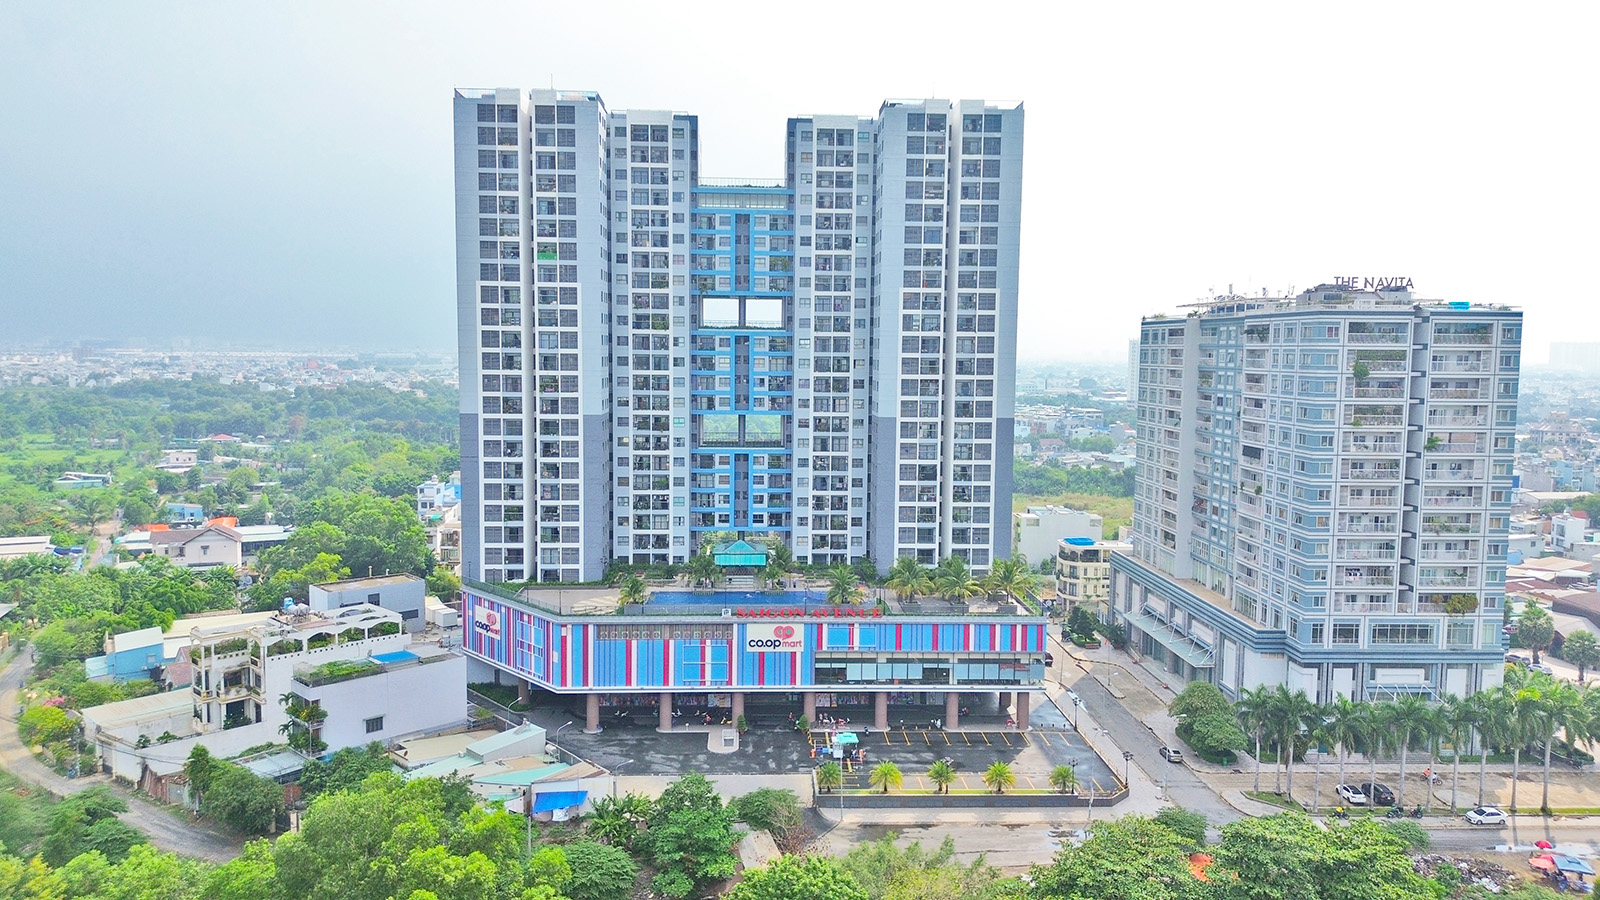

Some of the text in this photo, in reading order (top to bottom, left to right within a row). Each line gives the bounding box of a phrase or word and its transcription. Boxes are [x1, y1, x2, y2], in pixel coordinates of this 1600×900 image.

[1334, 276, 1414, 290] THE NAVITA
[737, 608, 883, 619] SAIGON AVENUE
